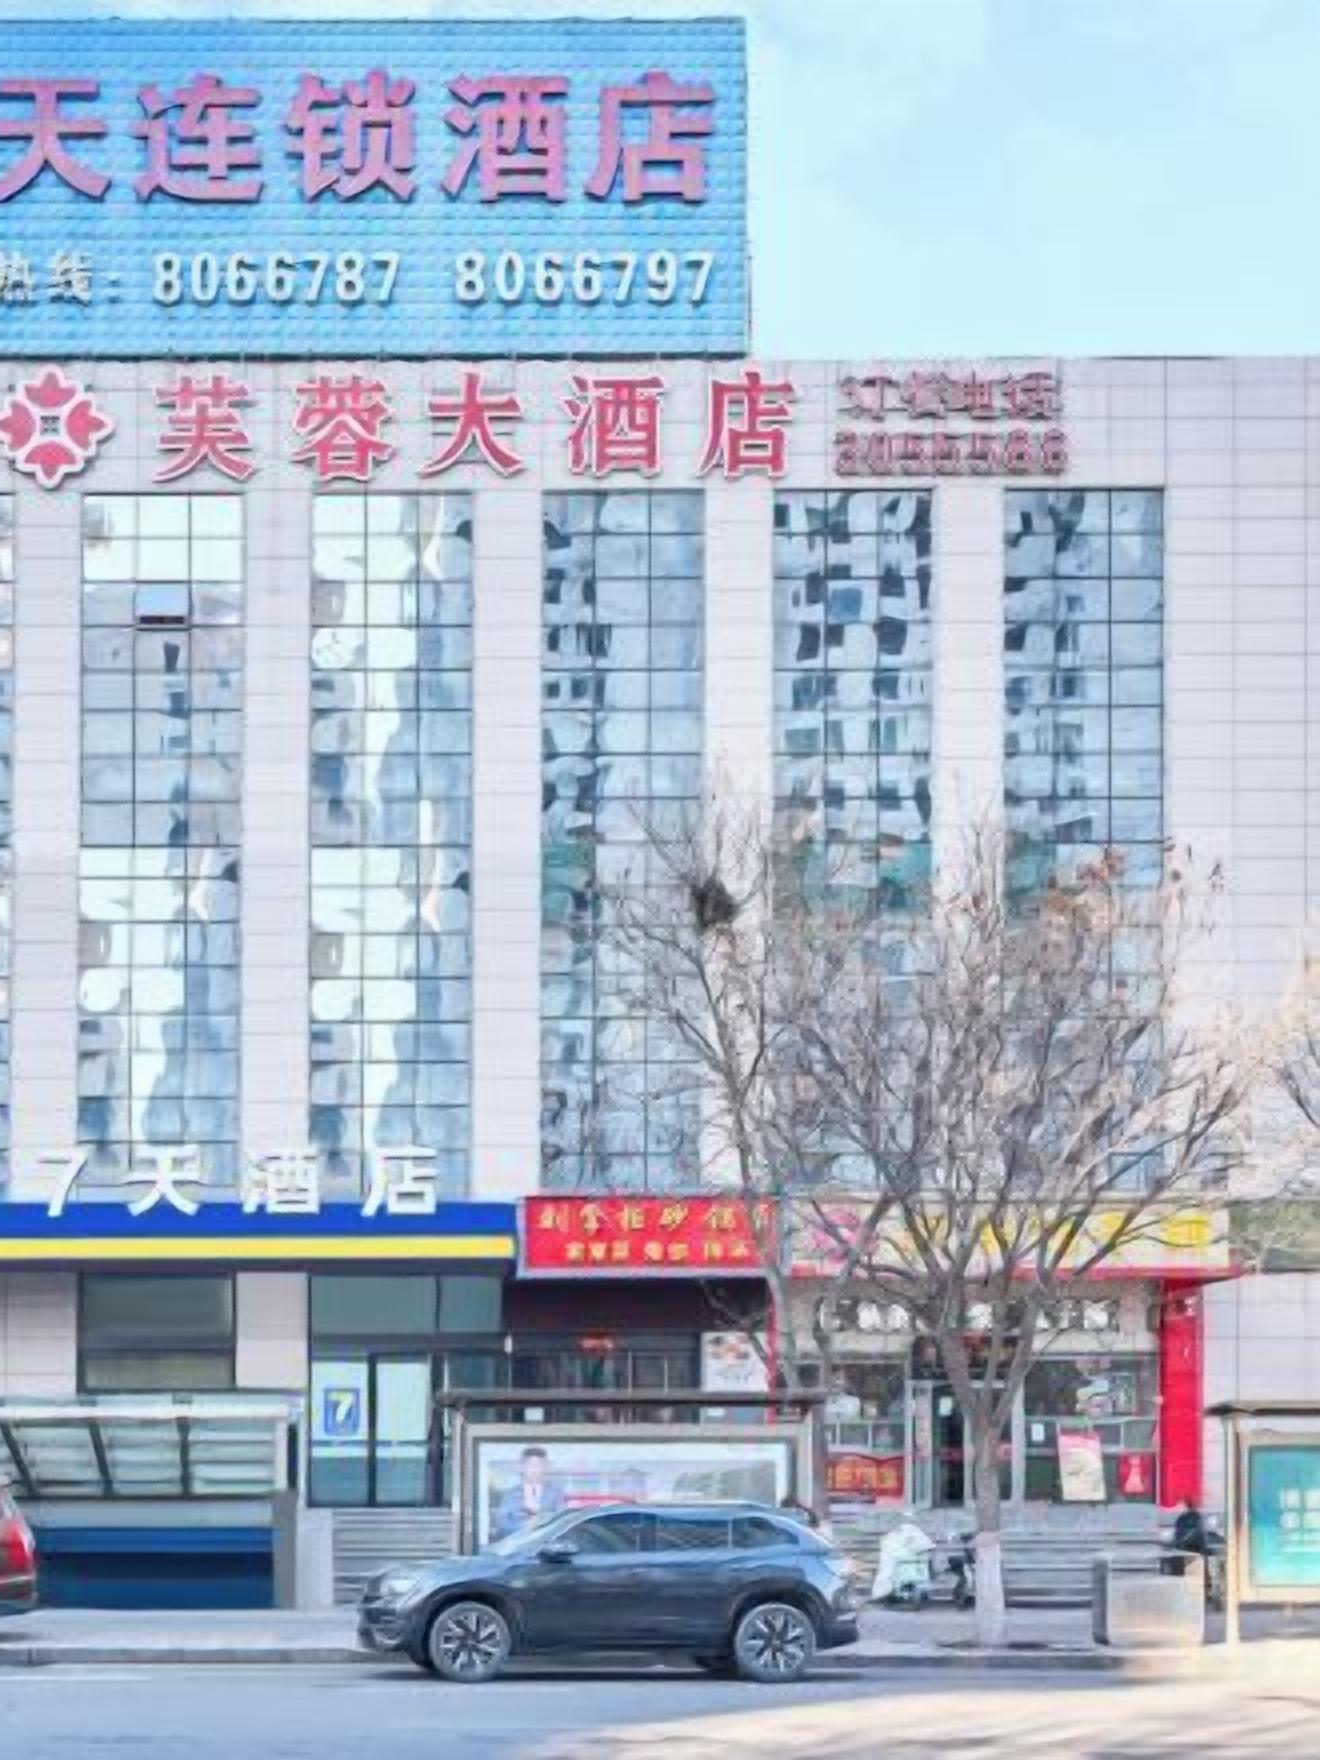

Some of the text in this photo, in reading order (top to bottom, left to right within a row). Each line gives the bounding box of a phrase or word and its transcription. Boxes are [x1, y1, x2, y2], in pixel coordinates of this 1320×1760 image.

[152, 250, 402, 307] 8066787
[454, 250, 716, 307] 8066797
[154, 370, 797, 482] 芙蓉大酒店
[37, 1142, 439, 1218] 7天酒店
